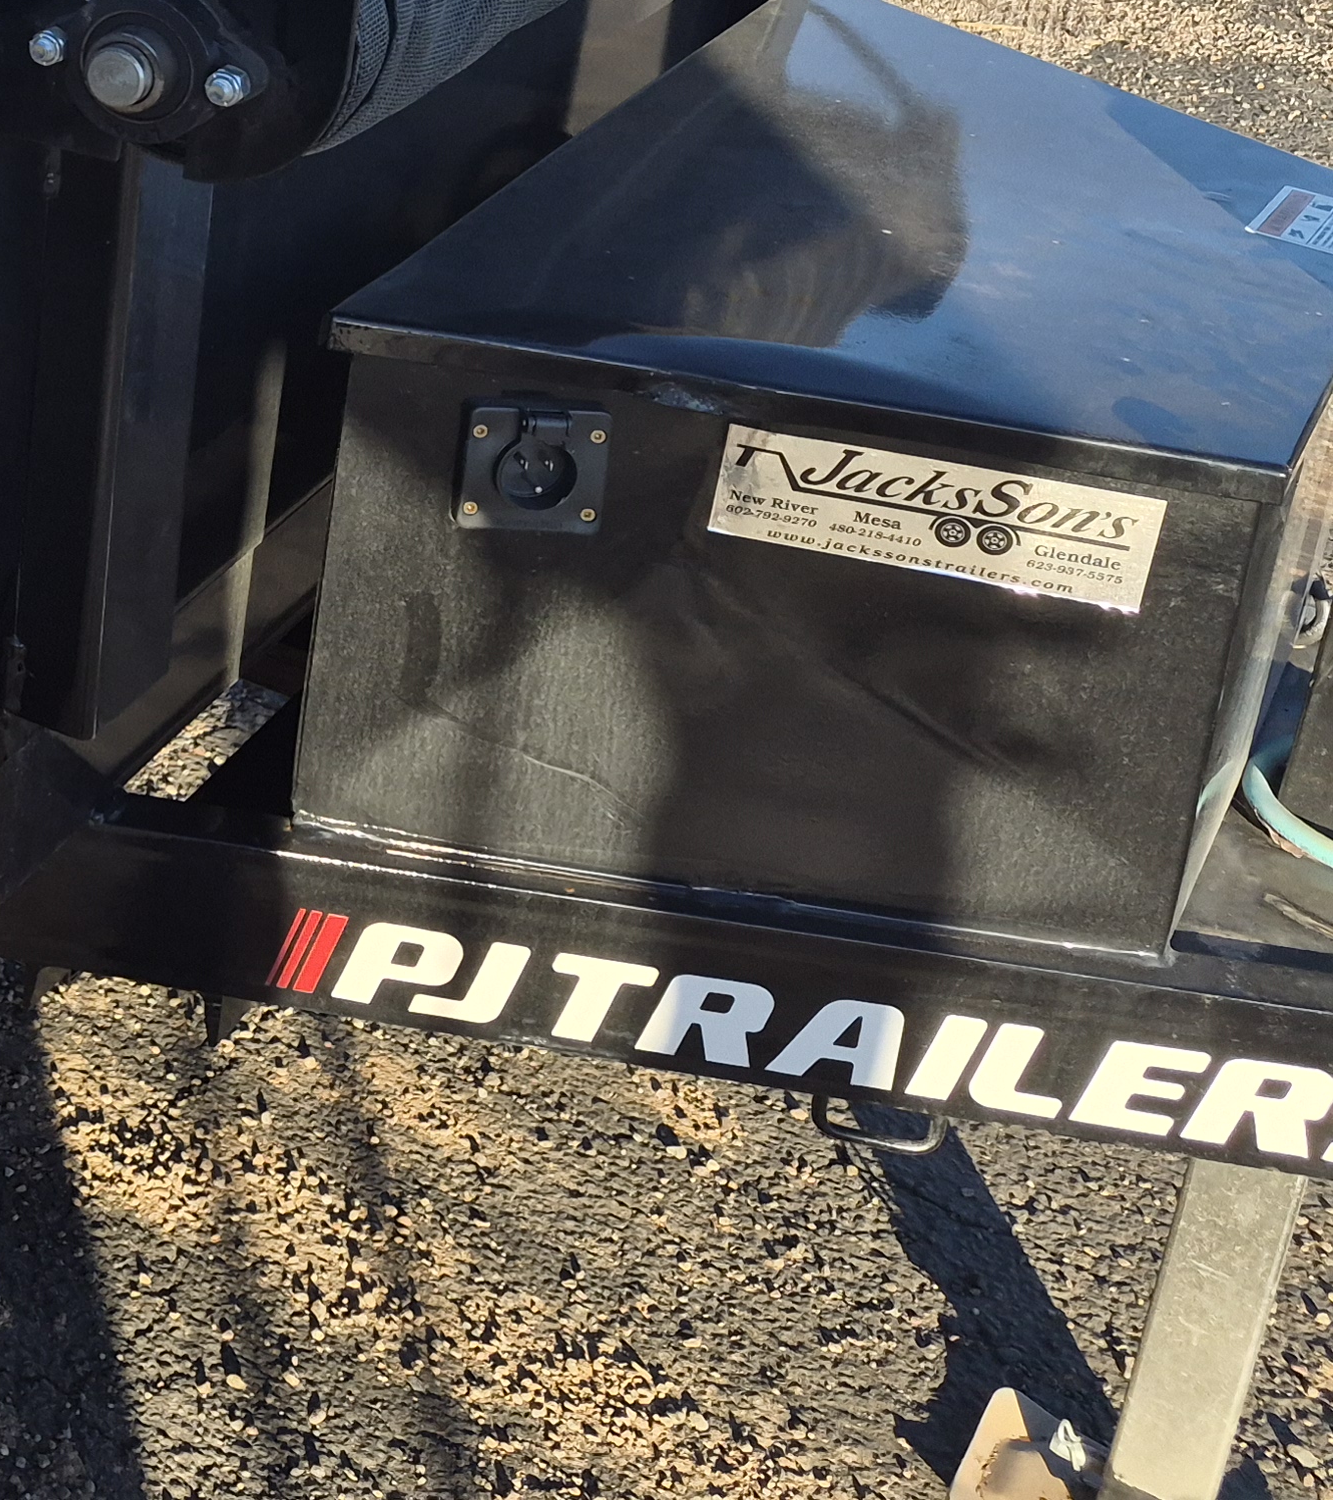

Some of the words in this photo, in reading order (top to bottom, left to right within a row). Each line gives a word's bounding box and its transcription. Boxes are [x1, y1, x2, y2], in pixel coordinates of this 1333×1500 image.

[729, 489, 766, 506] New
[770, 497, 819, 516] River
[798, 448, 1140, 539] JacksSon's
[725, 503, 818, 528] 602-792-9270
[852, 510, 902, 530] Mesa
[828, 523, 922, 547] 480-218-4410
[766, 529, 1074, 594] www.jackssonstrailers.com
[1033, 544, 1123, 571] Glendale
[1025, 559, 1124, 585] 623-937-5575
[549, 951, 1333, 1160] TRAILER
